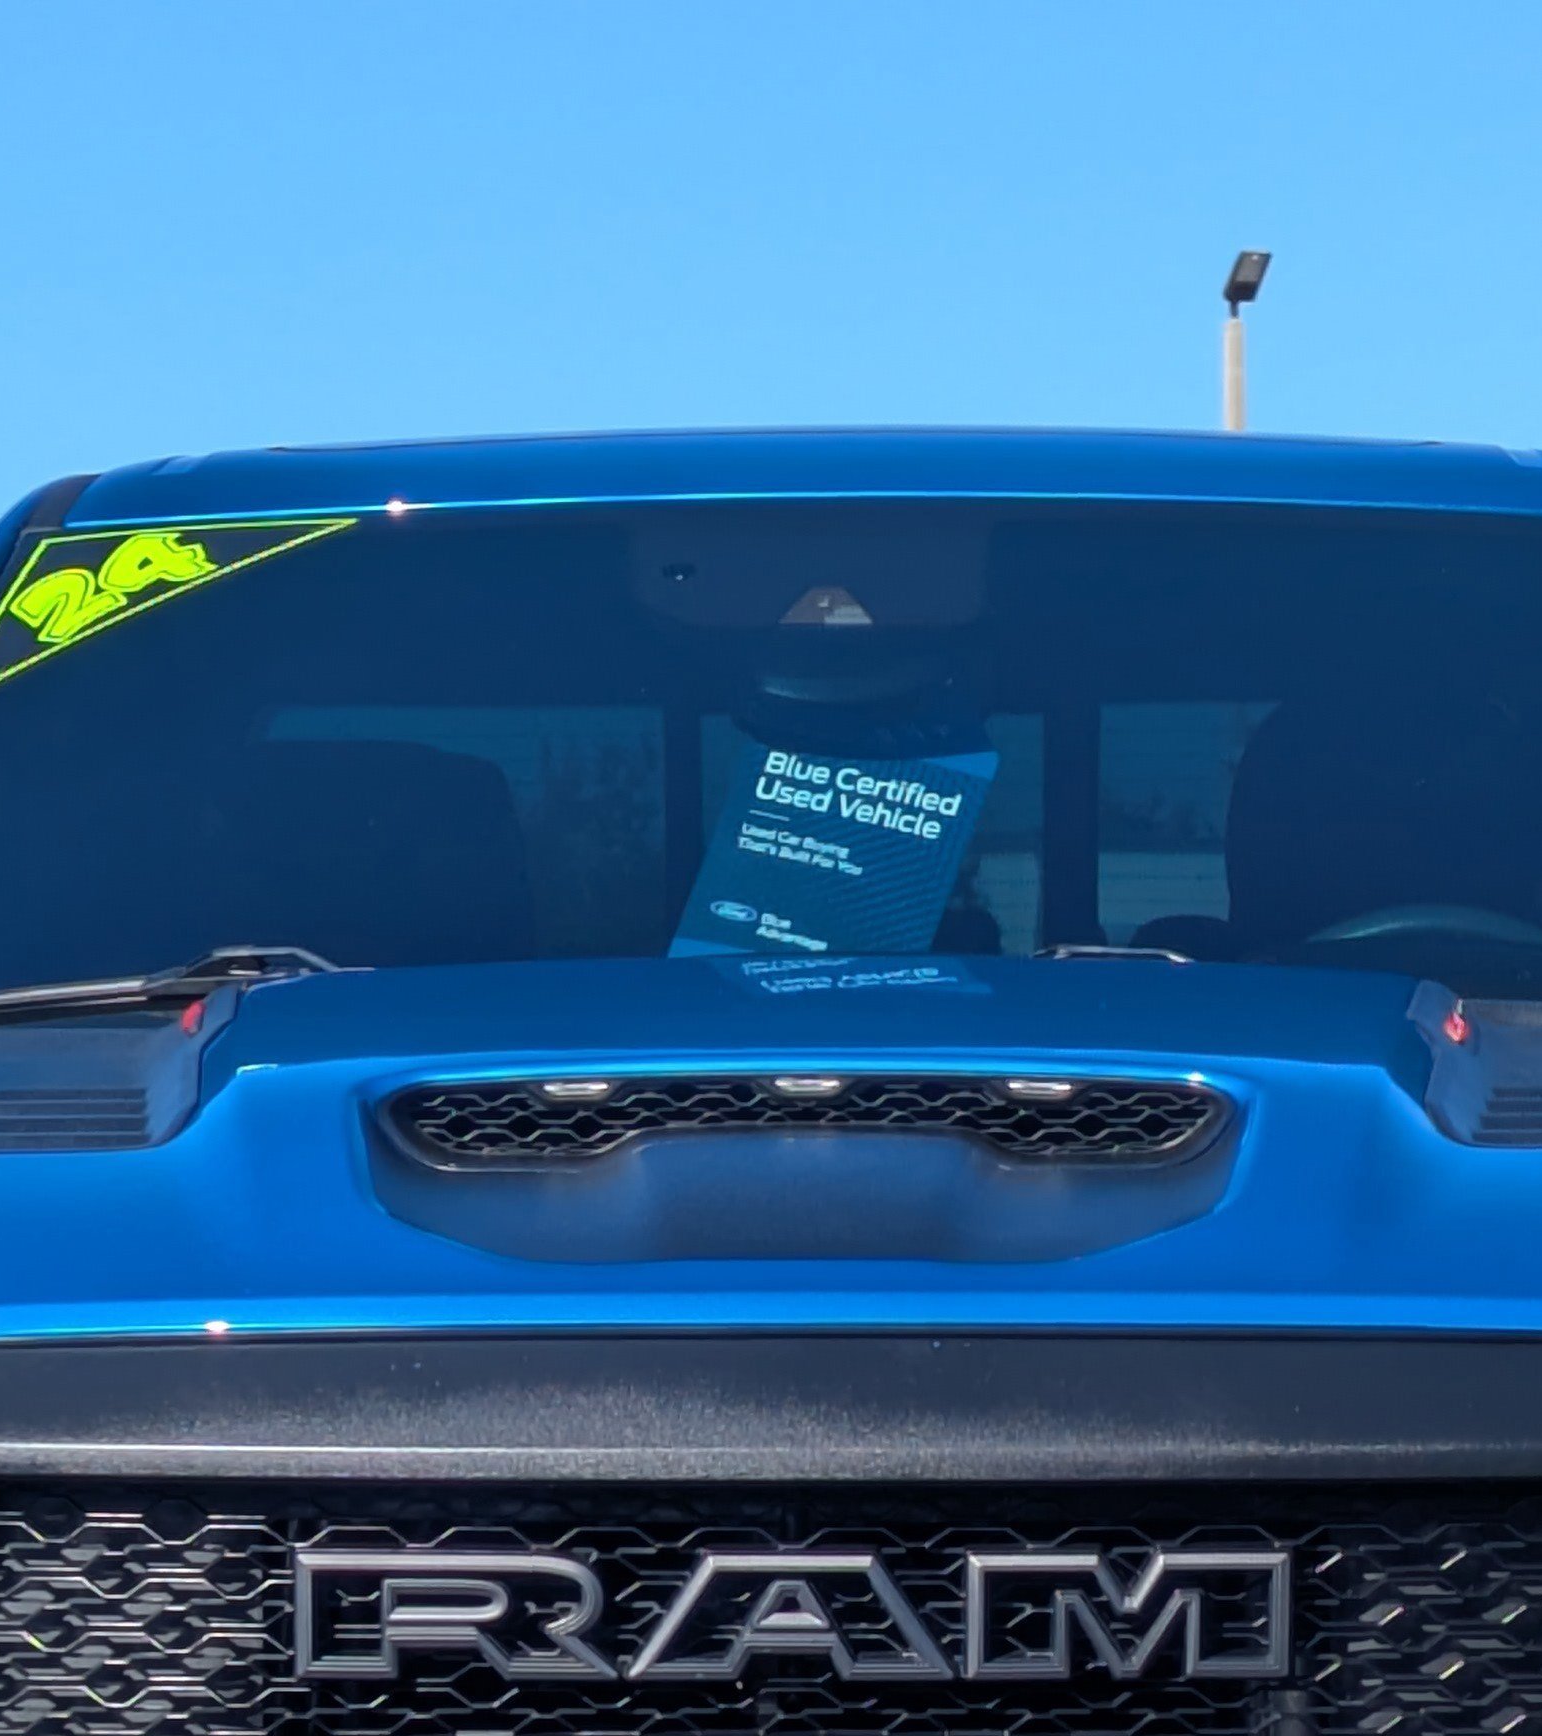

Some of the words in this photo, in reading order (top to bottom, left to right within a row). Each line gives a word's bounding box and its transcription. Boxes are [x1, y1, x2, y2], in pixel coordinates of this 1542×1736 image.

[756, 776, 833, 813] Used
[839, 794, 941, 839] Vehicle
[764, 751, 830, 784] Blue
[835, 768, 962, 816] Certified
[294, 1549, 1292, 1681] RAM
